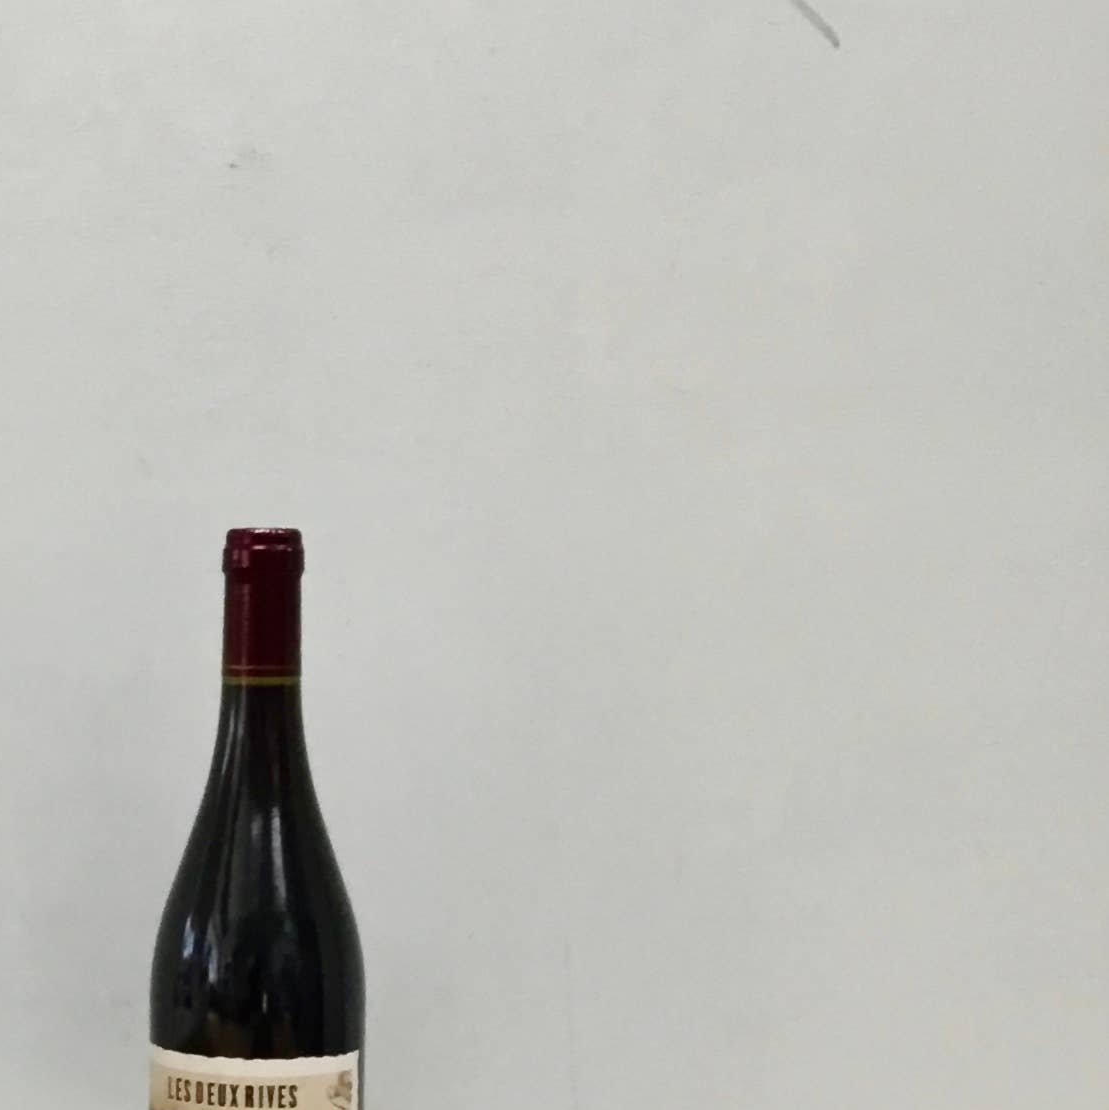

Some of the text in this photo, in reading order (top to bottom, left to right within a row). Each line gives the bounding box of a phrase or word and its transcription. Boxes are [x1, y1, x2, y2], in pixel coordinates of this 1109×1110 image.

[167, 1075, 299, 1109] LES DEUX RIVES
